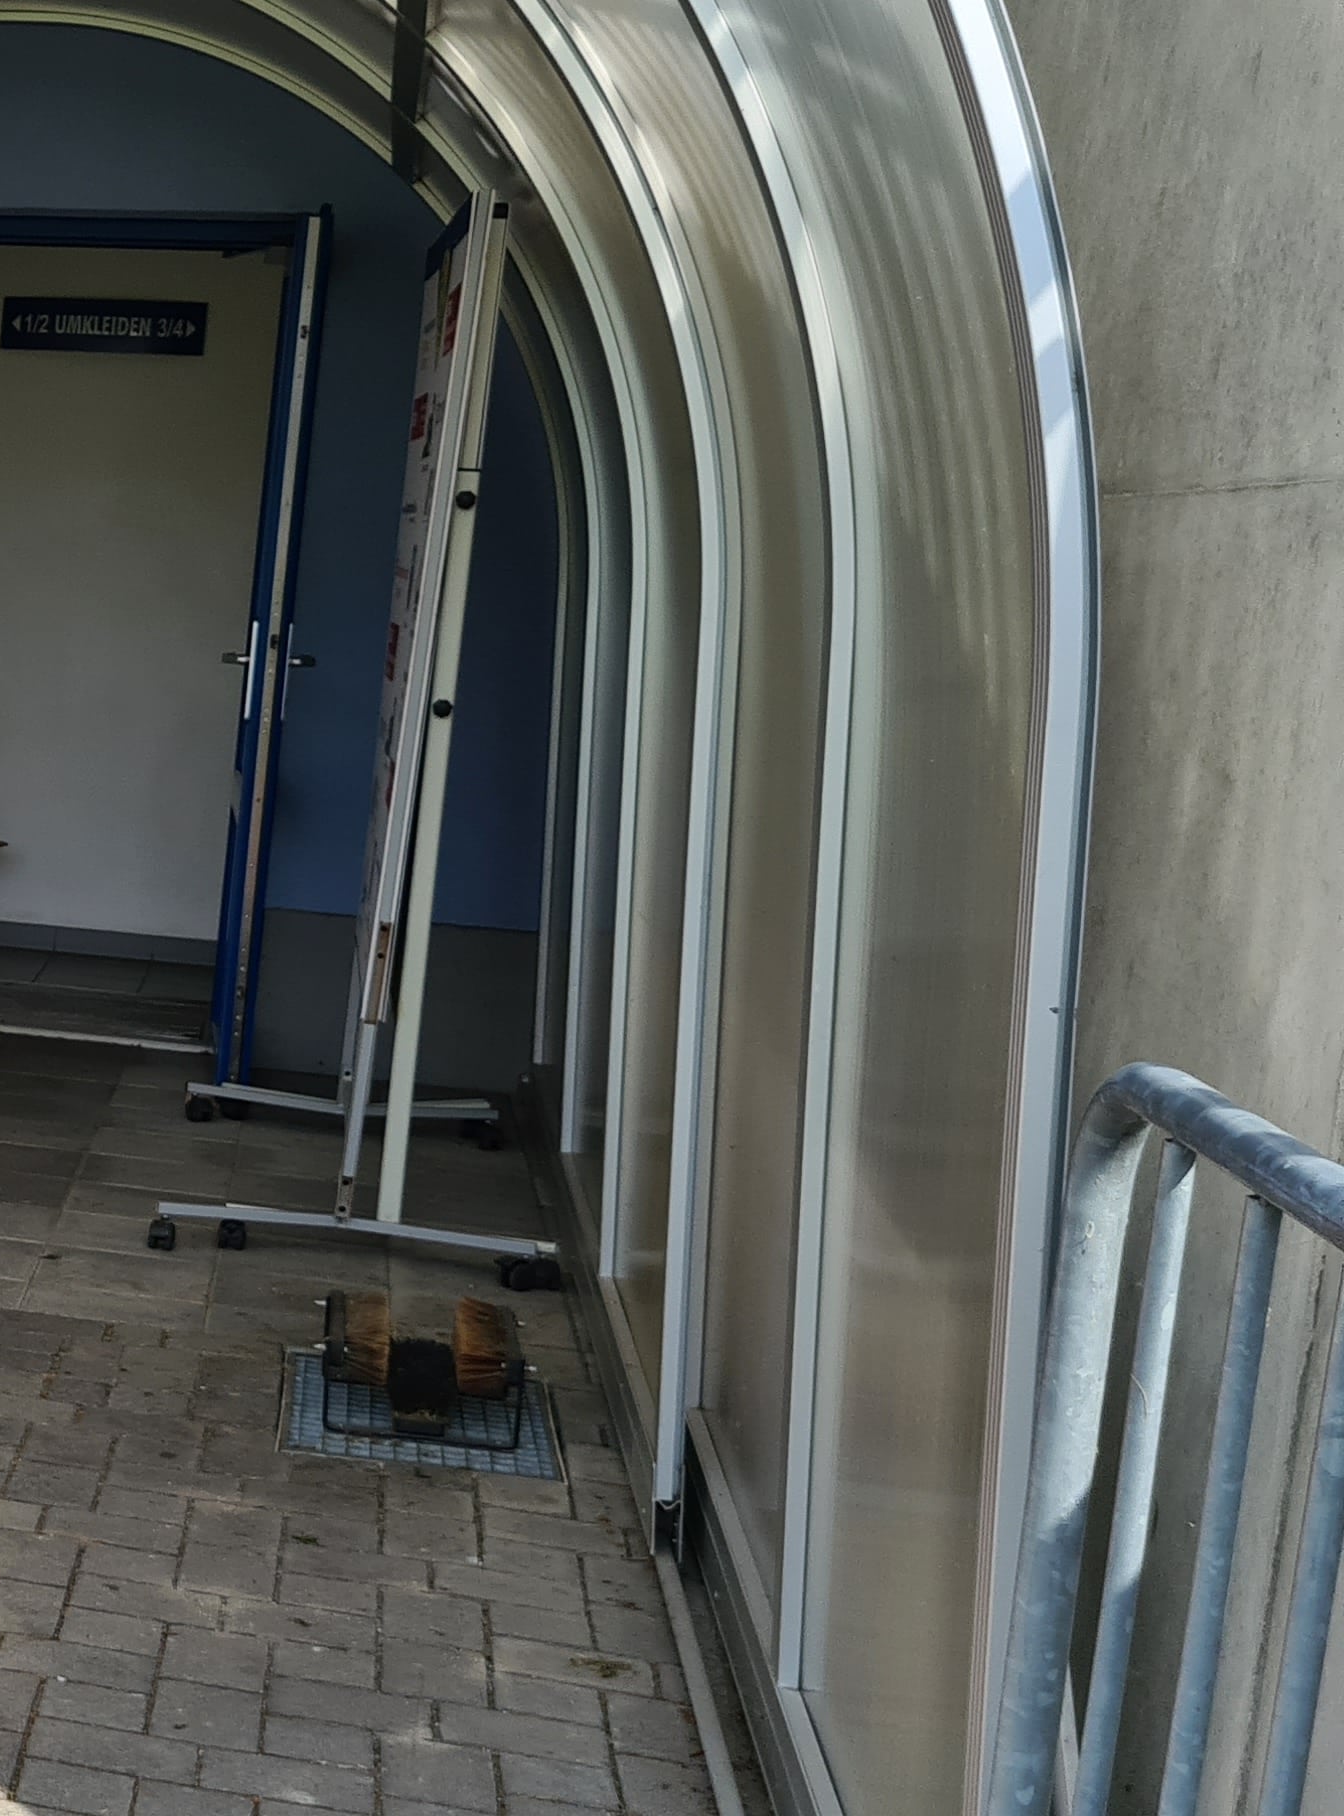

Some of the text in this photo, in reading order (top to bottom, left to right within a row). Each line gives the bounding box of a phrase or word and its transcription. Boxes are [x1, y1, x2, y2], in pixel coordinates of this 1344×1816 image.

[24, 313, 184, 338] 1/2 UMKLEIDEN 3/4
